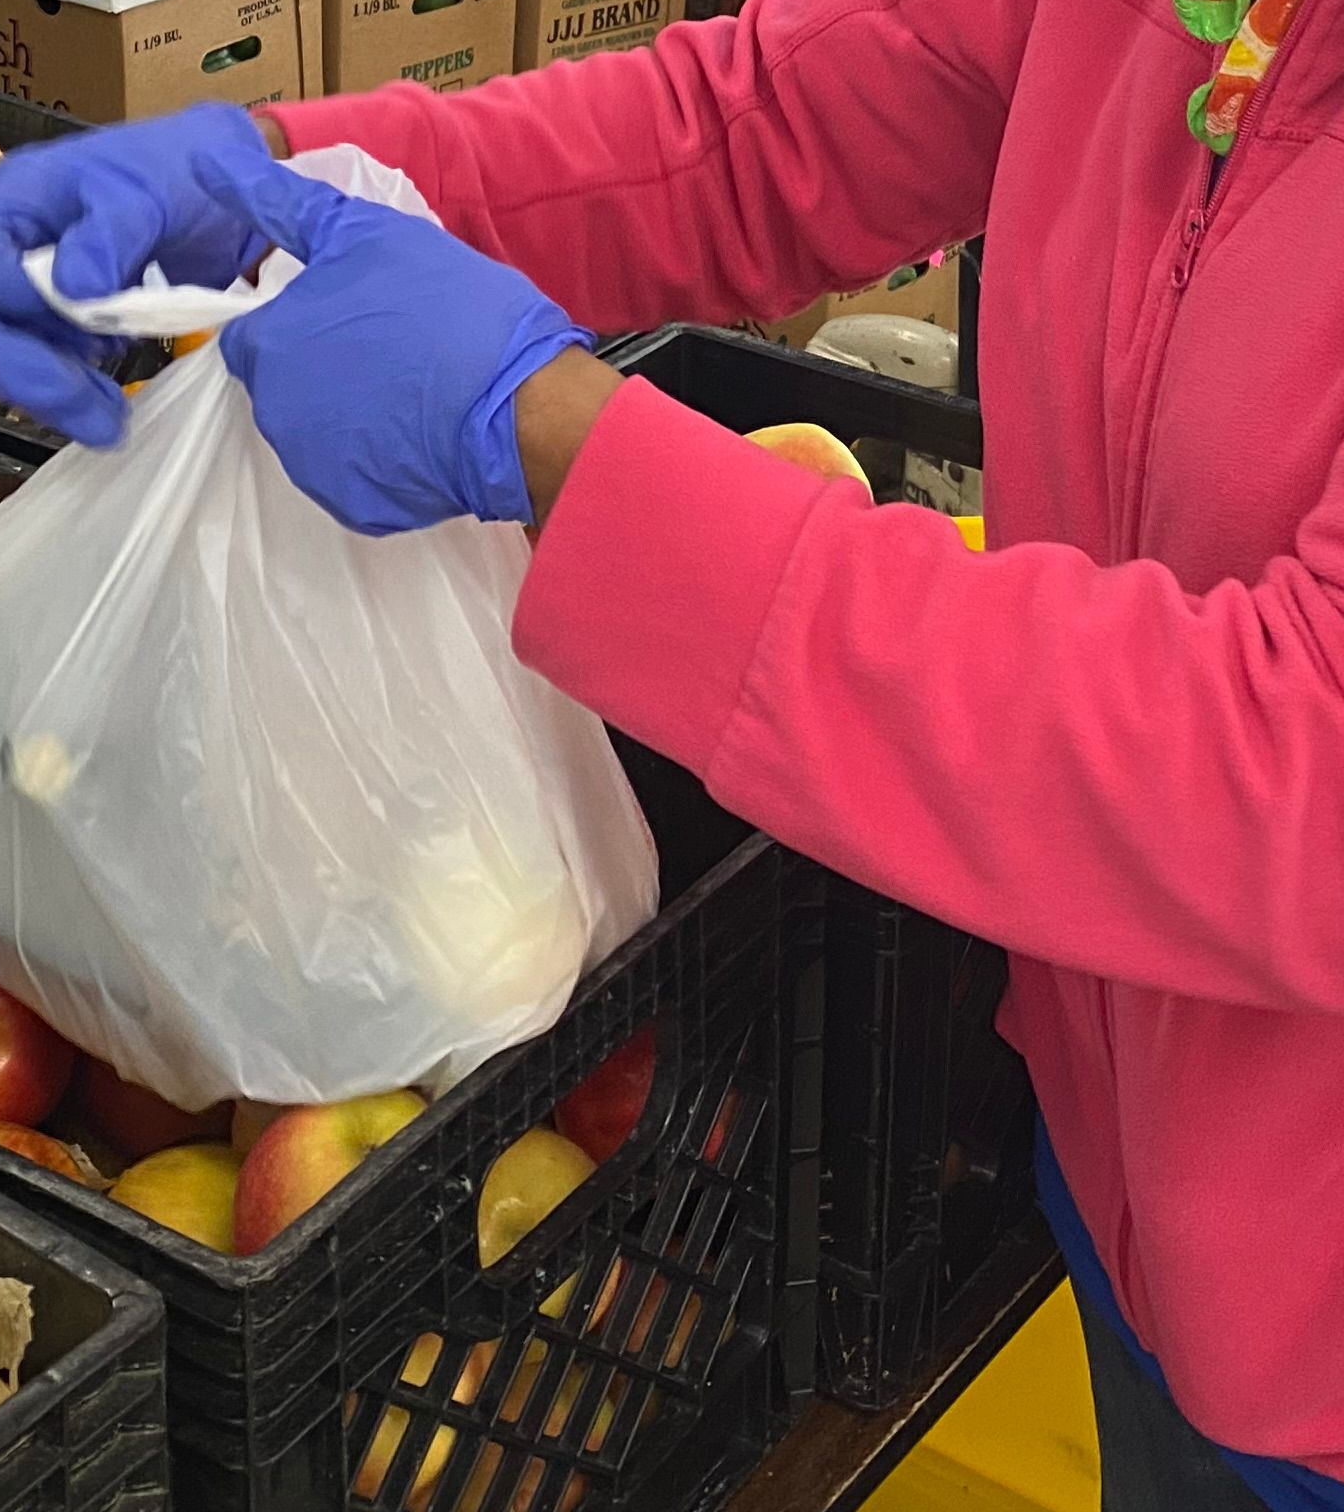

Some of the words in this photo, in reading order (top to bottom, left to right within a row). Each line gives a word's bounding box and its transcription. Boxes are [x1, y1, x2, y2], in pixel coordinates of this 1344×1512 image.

[364, 0, 380, 15] 1/9
[241, 16, 253, 26] OF
[547, 12, 585, 43] JJJ
[143, 35, 161, 50] 1/9
[165, 29, 181, 44] BU.
[401, 47, 474, 82] PEPPERS
